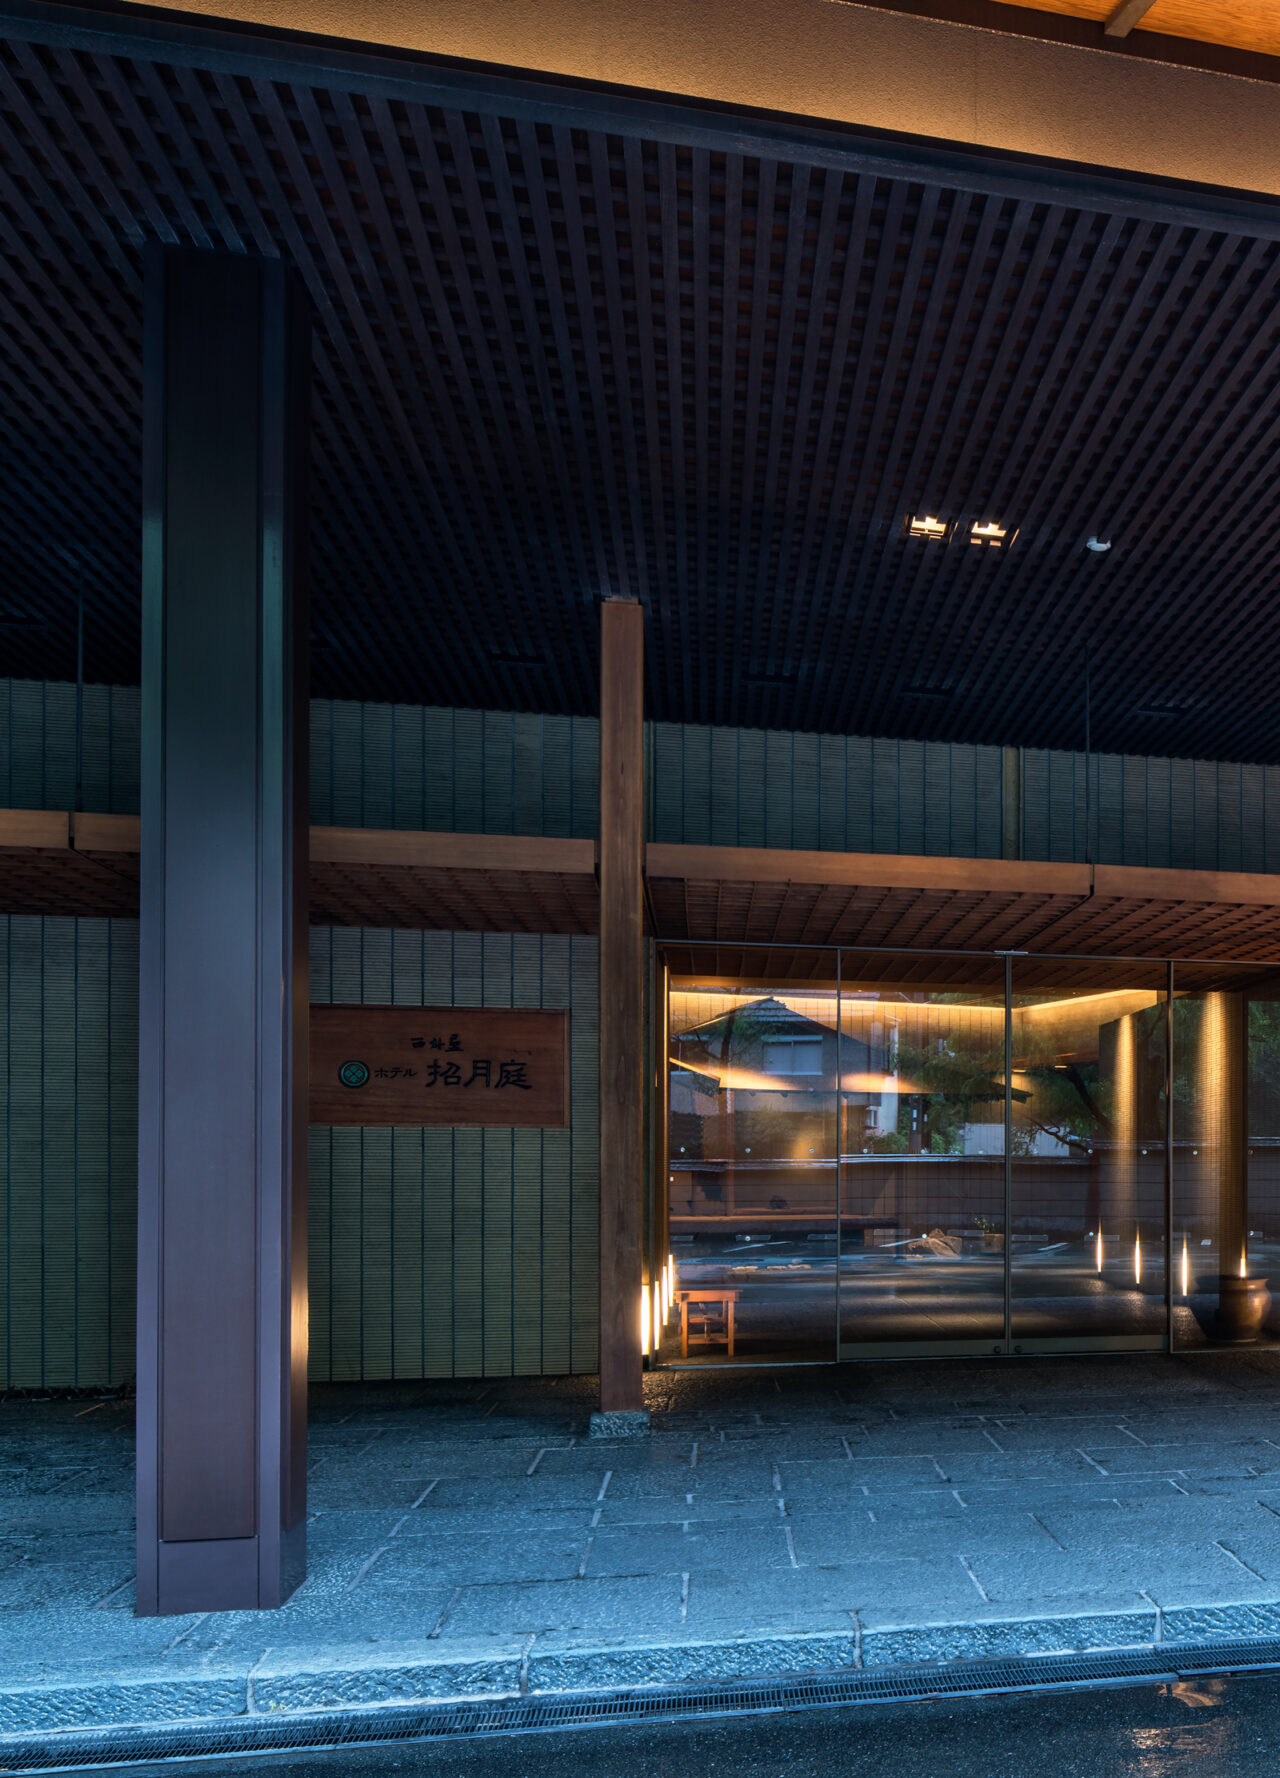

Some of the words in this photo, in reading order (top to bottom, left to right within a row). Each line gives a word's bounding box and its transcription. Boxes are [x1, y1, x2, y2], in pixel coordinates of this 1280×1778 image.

[374, 1067, 418, 1079] ホテル
[425, 1058, 533, 1090] 招月庭
